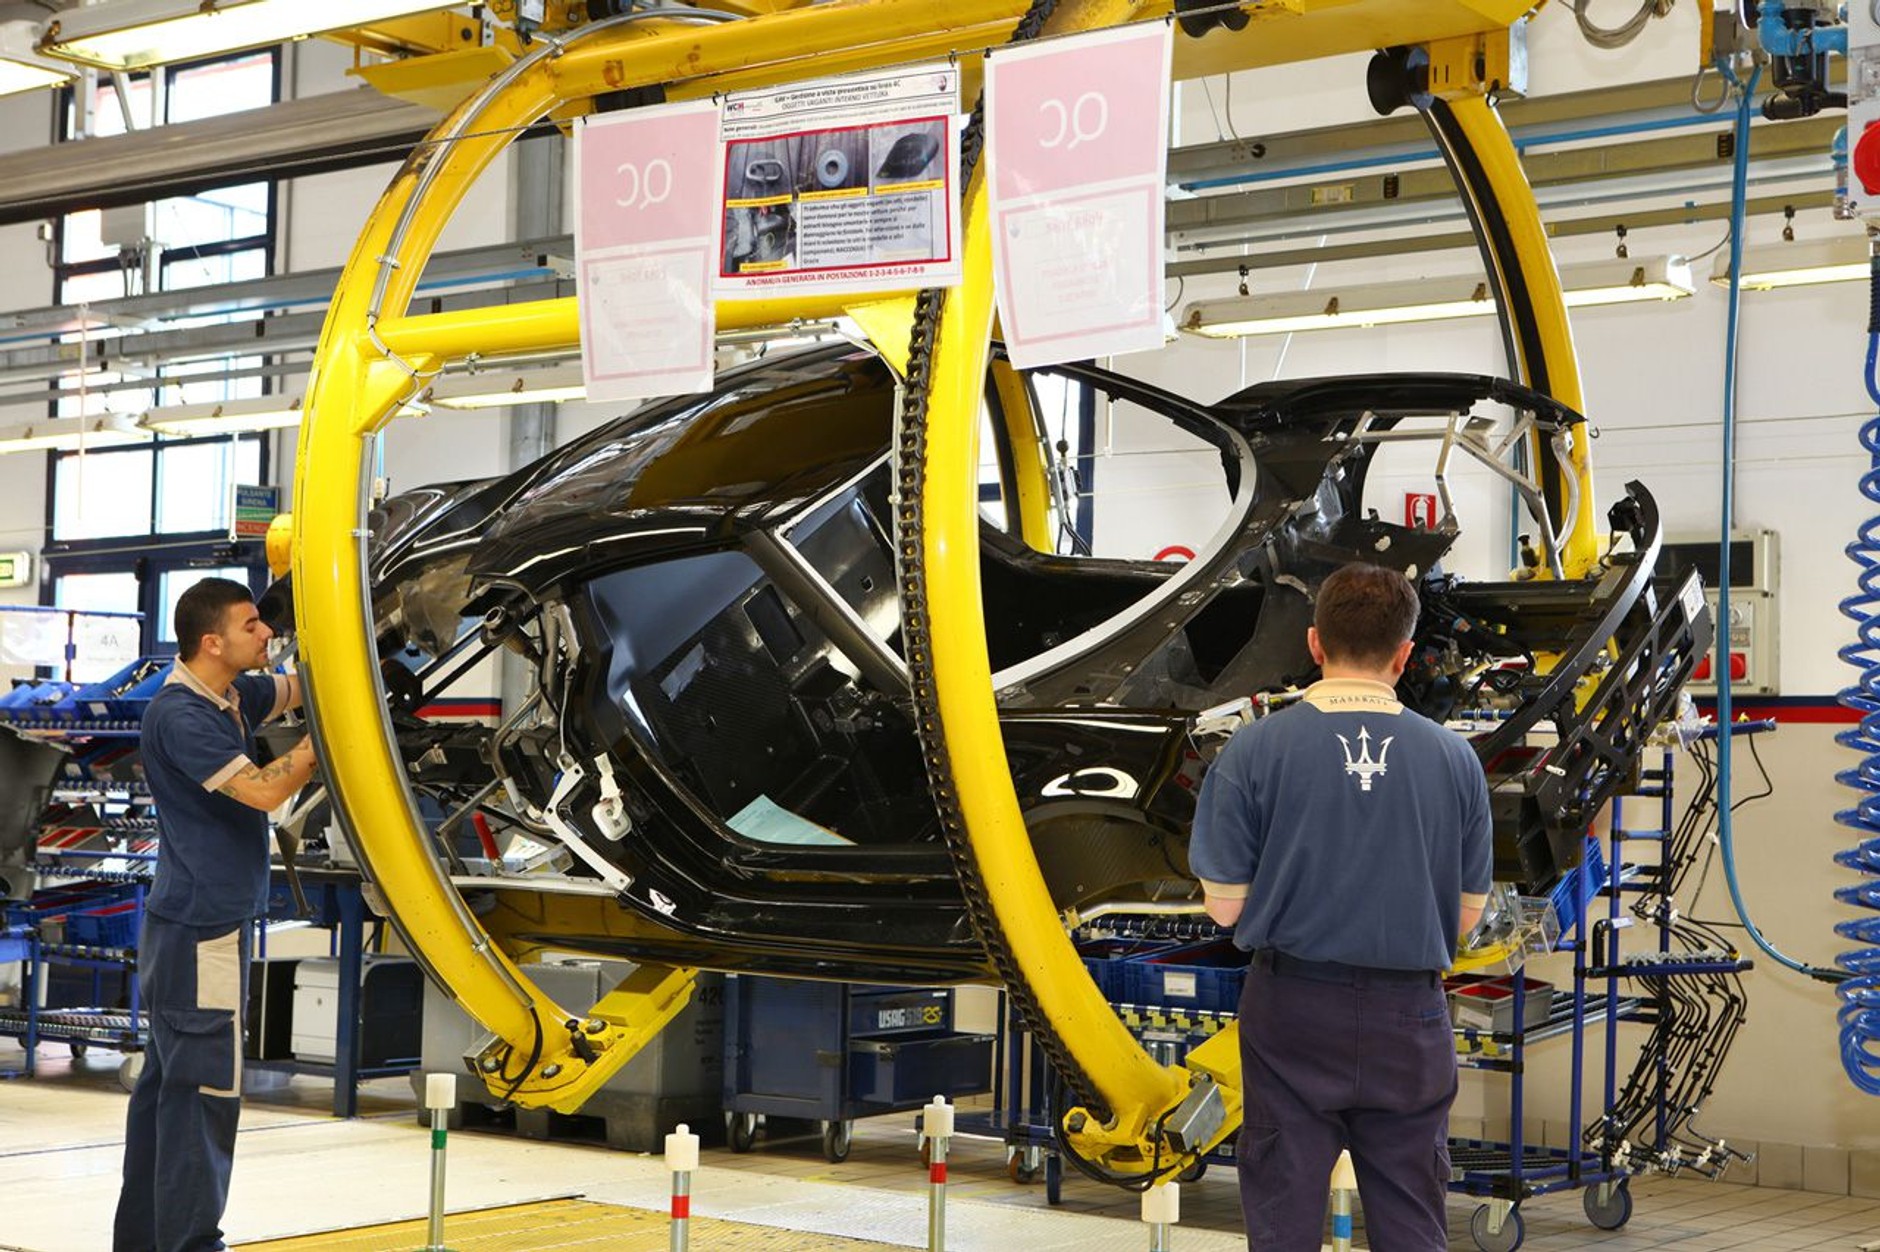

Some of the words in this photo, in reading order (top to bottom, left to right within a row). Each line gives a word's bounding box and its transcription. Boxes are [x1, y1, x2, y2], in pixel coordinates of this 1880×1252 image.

[825, 269, 868, 280] POSTAZIONE
[100, 634, 119, 647] 4A
[878, 1008, 905, 1029] USAG
